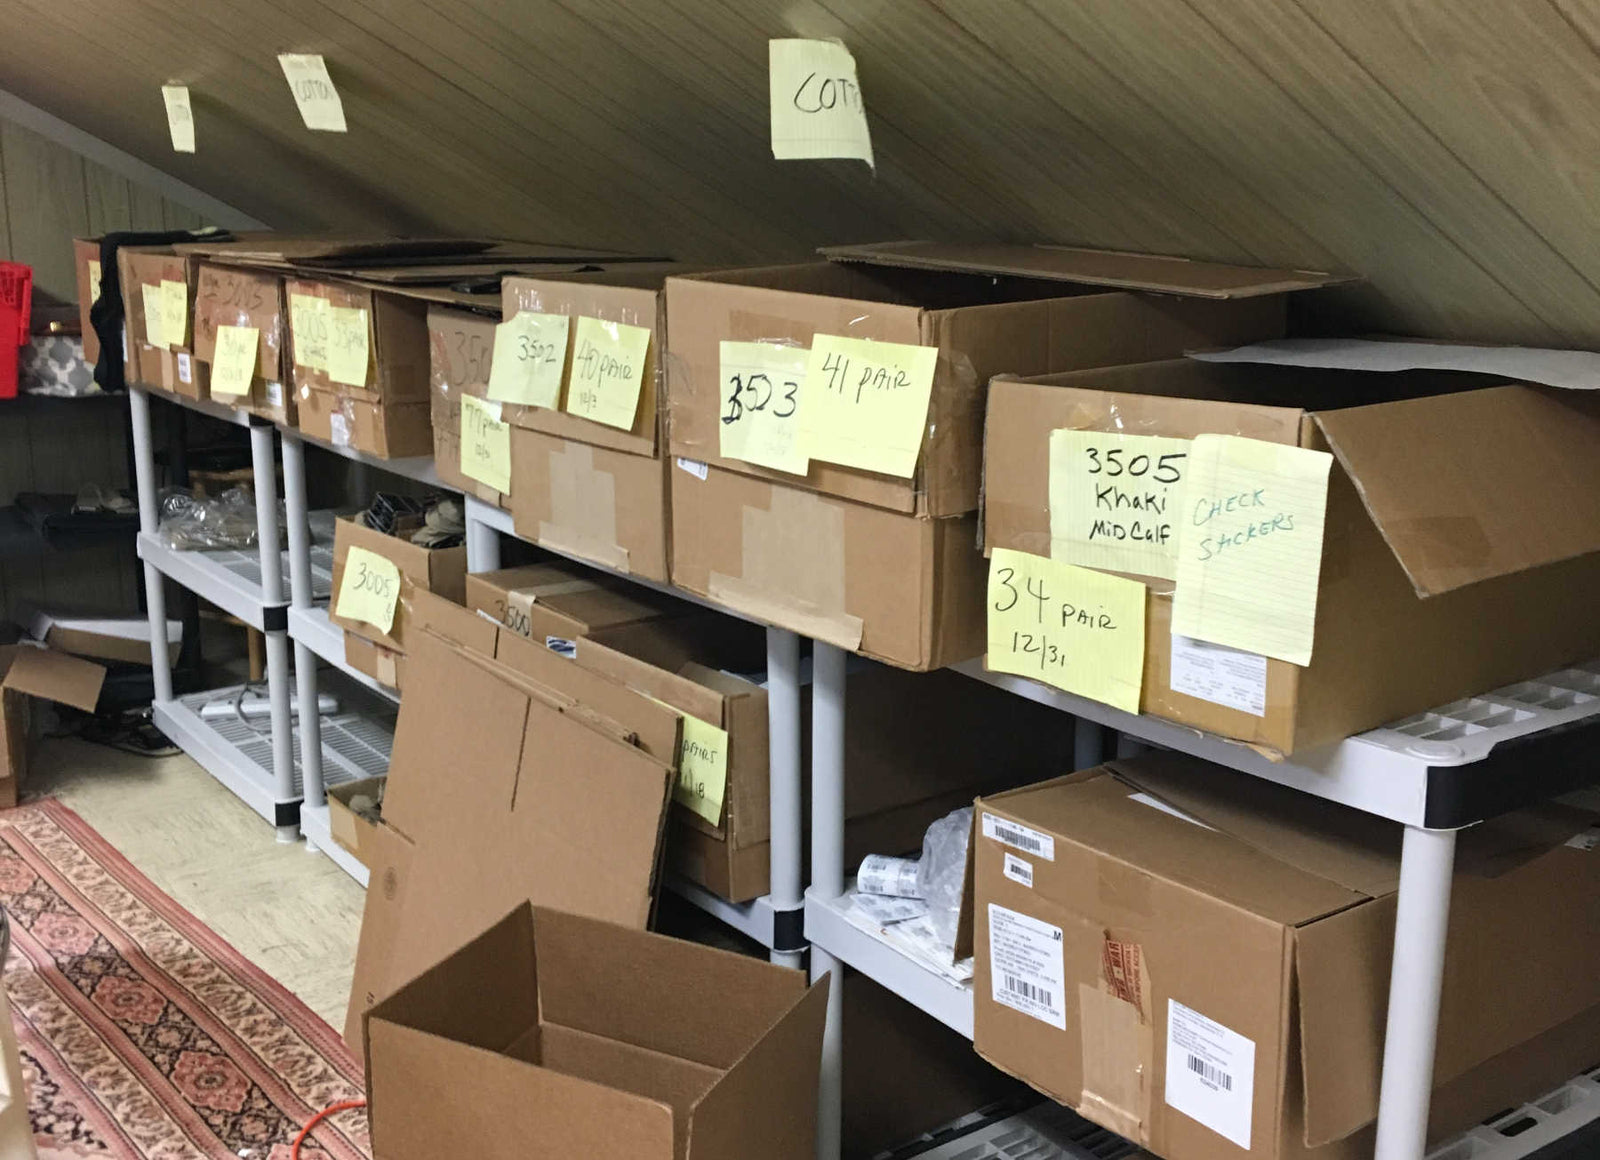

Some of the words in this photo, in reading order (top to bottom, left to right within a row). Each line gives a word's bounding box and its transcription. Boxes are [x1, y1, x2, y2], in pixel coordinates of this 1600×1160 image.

[518, 335, 557, 363] 3502
[577, 338, 599, 381] 40
[822, 352, 849, 394] 41
[1086, 447, 1187, 483] 3505
[1096, 482, 1168, 513] Khaki
[1193, 488, 1266, 526] CHECK
[353, 562, 394, 598] 3005
[994, 567, 1050, 624] 34
[1012, 631, 1066, 670] 12/31
